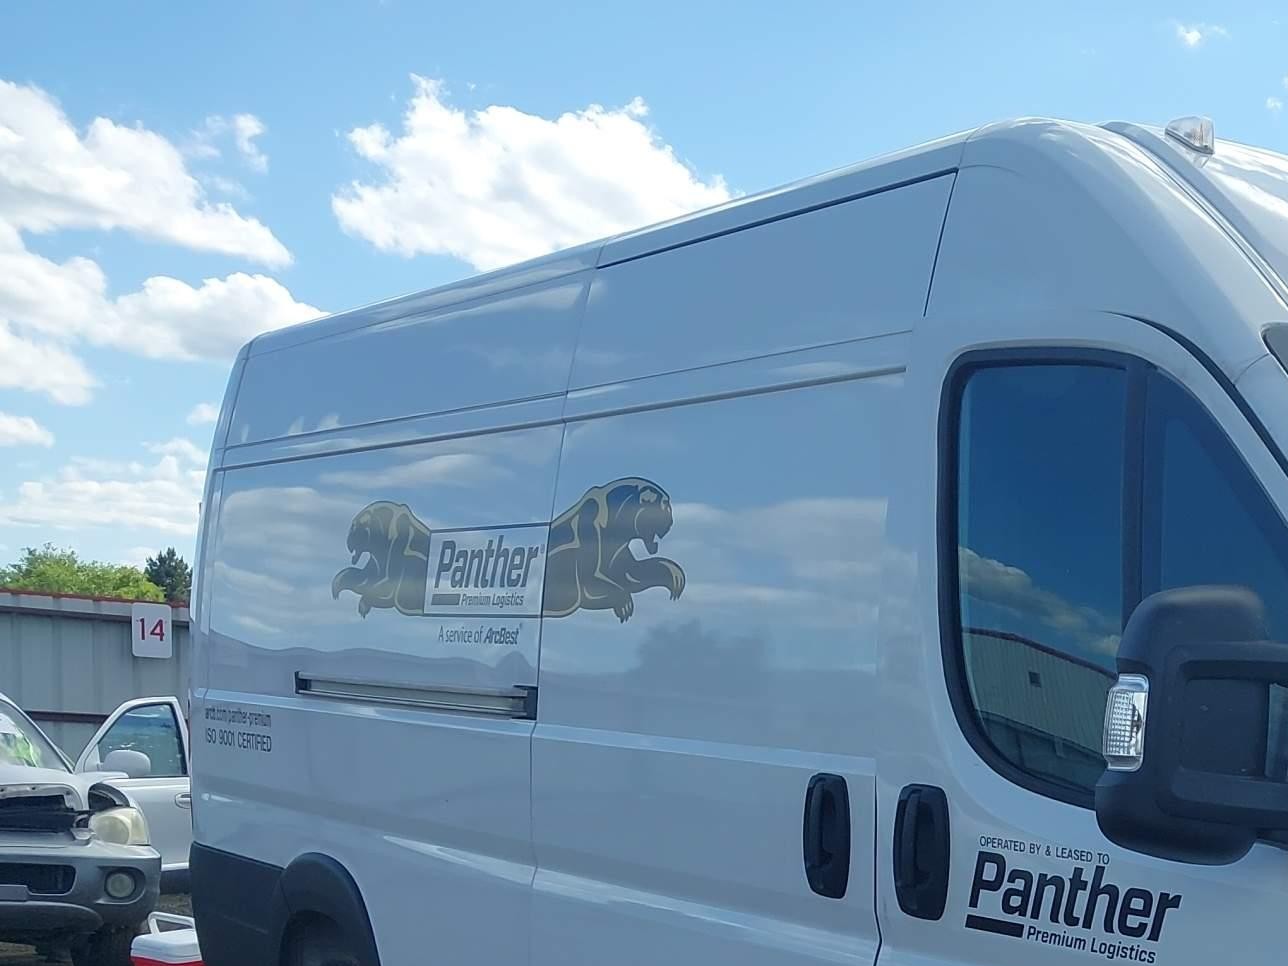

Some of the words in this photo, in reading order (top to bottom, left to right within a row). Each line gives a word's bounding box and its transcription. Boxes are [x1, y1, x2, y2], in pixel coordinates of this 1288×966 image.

[434, 534, 539, 589] Panther
[461, 593, 491, 606] Premium
[492, 592, 525, 609] Logistics
[139, 617, 165, 642] 14
[438, 625, 446, 641] A
[446, 626, 473, 644] service
[474, 625, 485, 644] of
[484, 627, 520, 645] ArcBest
[206, 728, 217, 744] ISO
[219, 729, 236, 747] 9001
[237, 731, 272, 753] CERTIFIED
[980, 836, 1026, 852] OPERATED
[1030, 844, 1042, 855] BY
[1045, 846, 1052, 857] &
[1055, 847, 1093, 863] LEASED
[1097, 853, 1110, 865] TO
[968, 850, 1183, 942] Panther
[1027, 926, 1087, 952] Premium
[1090, 937, 1157, 964] Logistics
